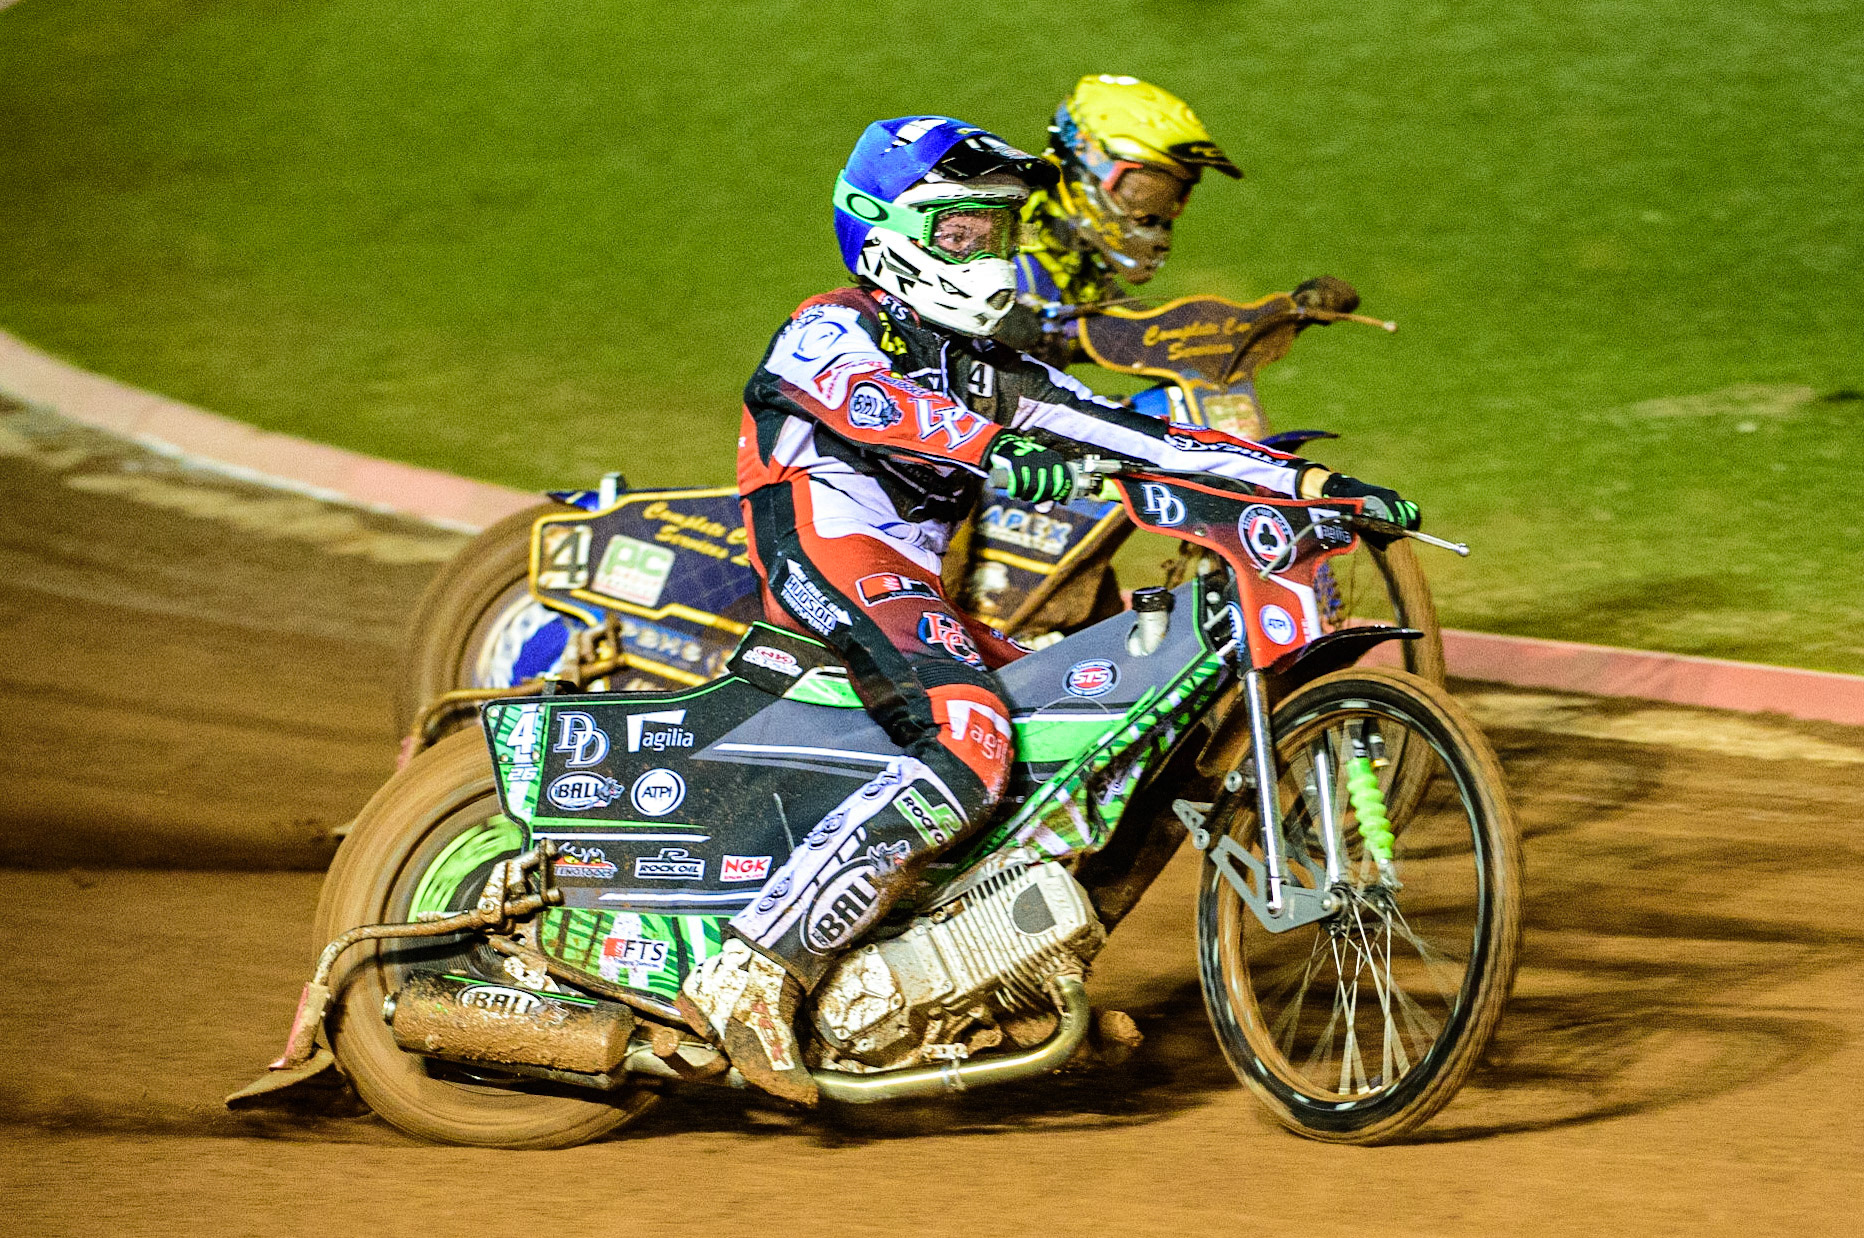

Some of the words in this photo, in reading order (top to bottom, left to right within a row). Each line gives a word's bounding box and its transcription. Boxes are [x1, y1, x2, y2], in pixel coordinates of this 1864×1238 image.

[968, 363, 987, 394] 4
[552, 528, 587, 585] 4
[1072, 670, 1109, 684] STS
[507, 711, 537, 755] 4
[642, 728, 695, 752] agilia
[969, 723, 1009, 760] agil
[507, 766, 538, 781] 26
[639, 864, 677, 873] ROCK
[678, 864, 700, 873] OIL
[725, 858, 768, 874] NGK
[623, 939, 665, 961] FTS
